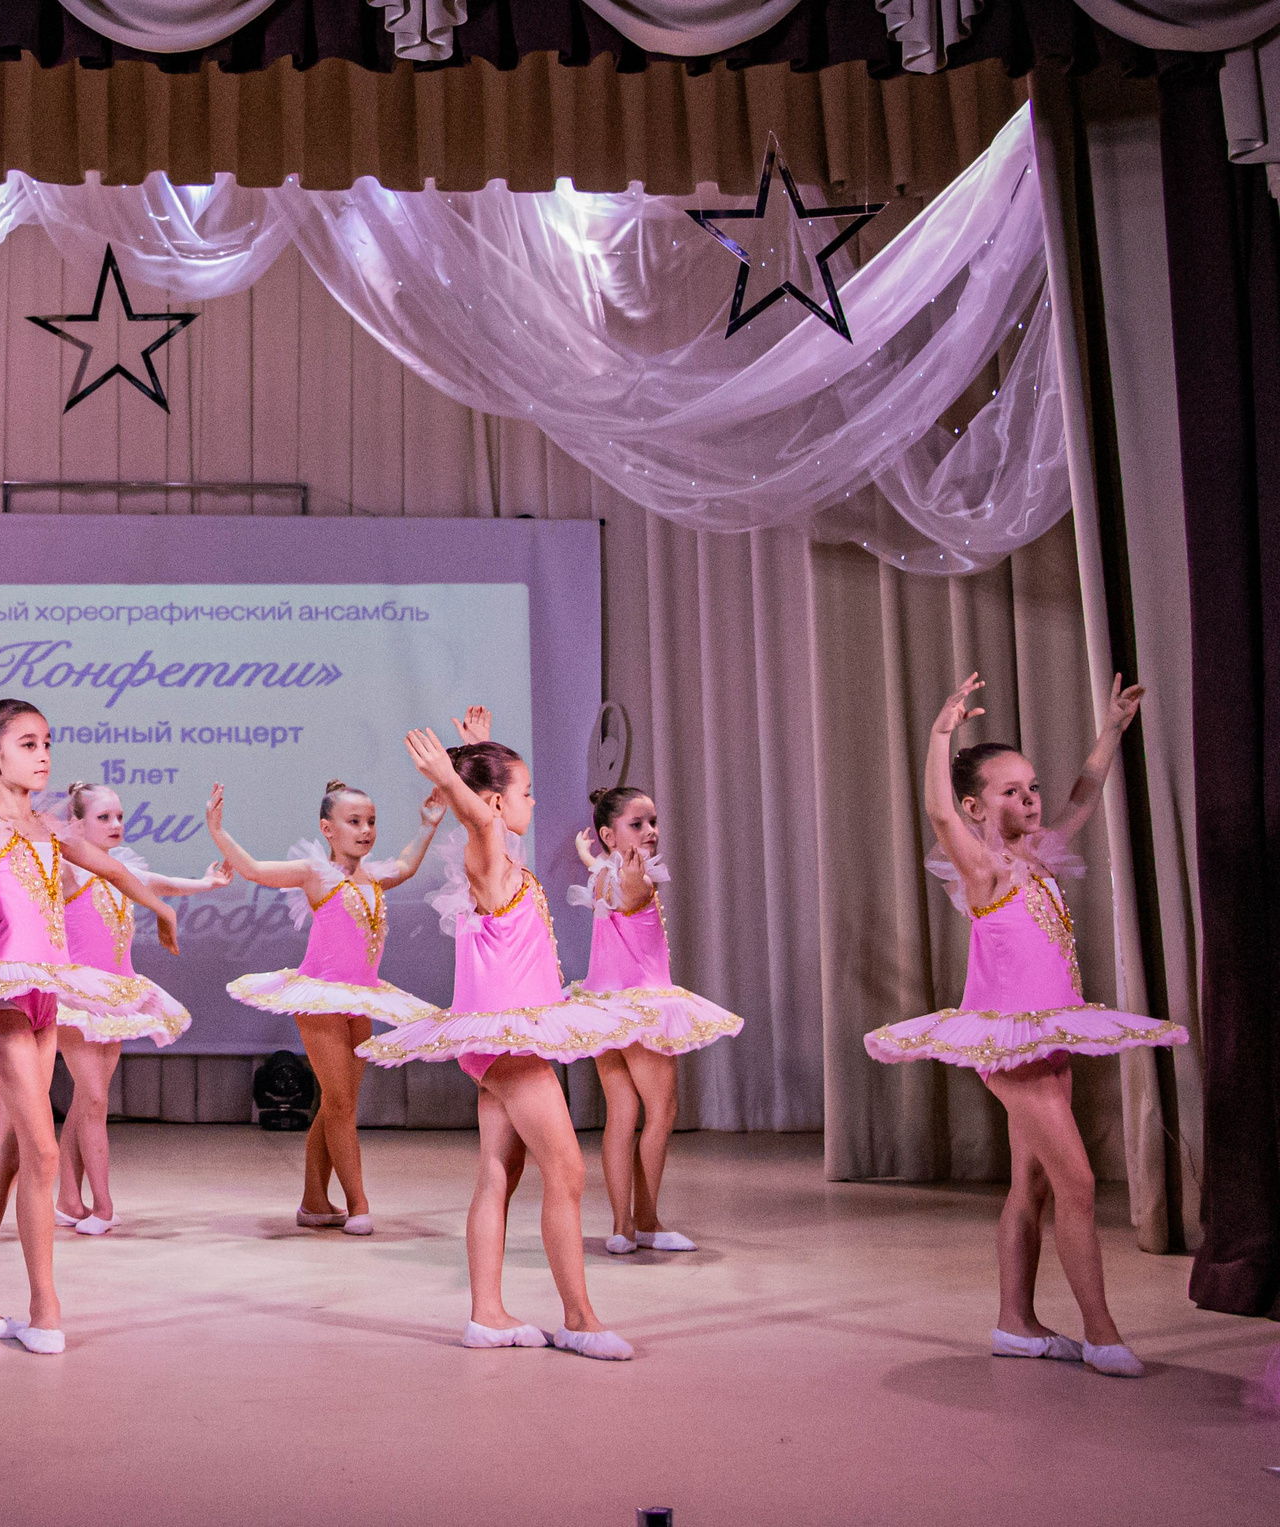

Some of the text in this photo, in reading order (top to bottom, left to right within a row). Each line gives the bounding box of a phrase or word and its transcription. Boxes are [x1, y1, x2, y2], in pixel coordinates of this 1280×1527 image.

[35, 602, 293, 625] хореографический
[298, 601, 430, 622] ансамбль
[50, 721, 304, 748] лейный концерт
